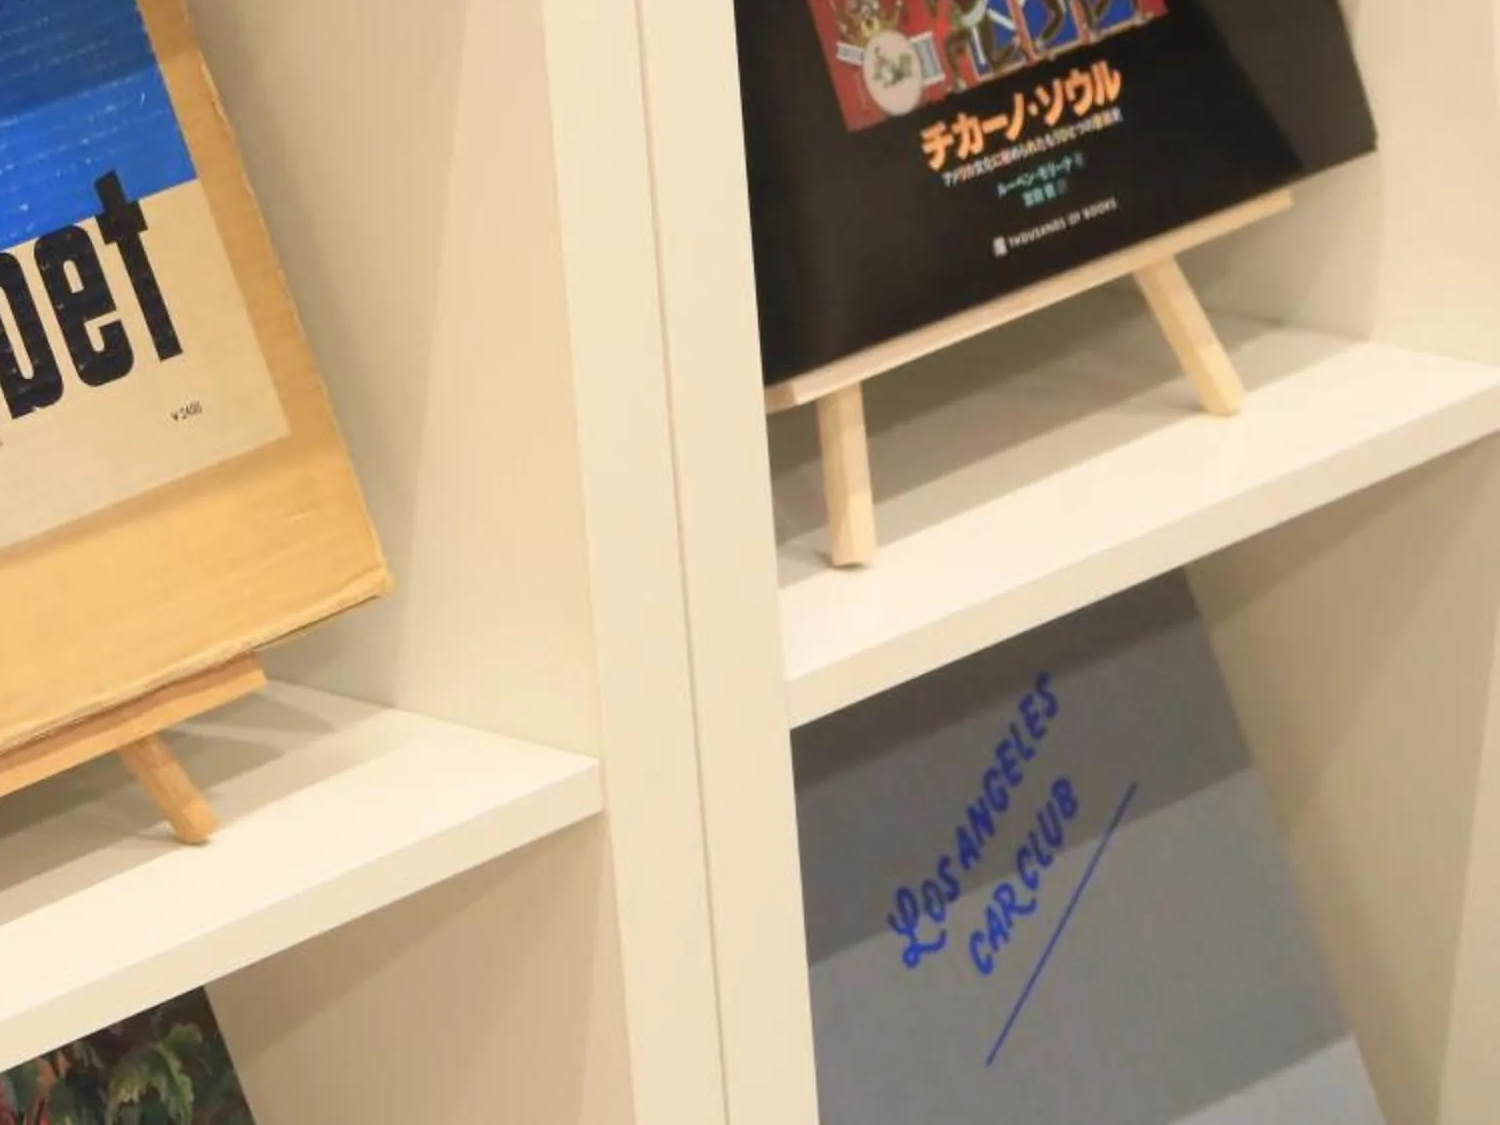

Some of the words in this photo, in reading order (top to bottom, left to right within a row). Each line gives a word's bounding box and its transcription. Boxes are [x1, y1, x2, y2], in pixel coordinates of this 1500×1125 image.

[919, 60, 1123, 171] チカーノ・ソウル
[953, 672, 1059, 872] ANGELES
[967, 881, 1037, 976] CAR
[1014, 777, 1081, 890] CLUB
